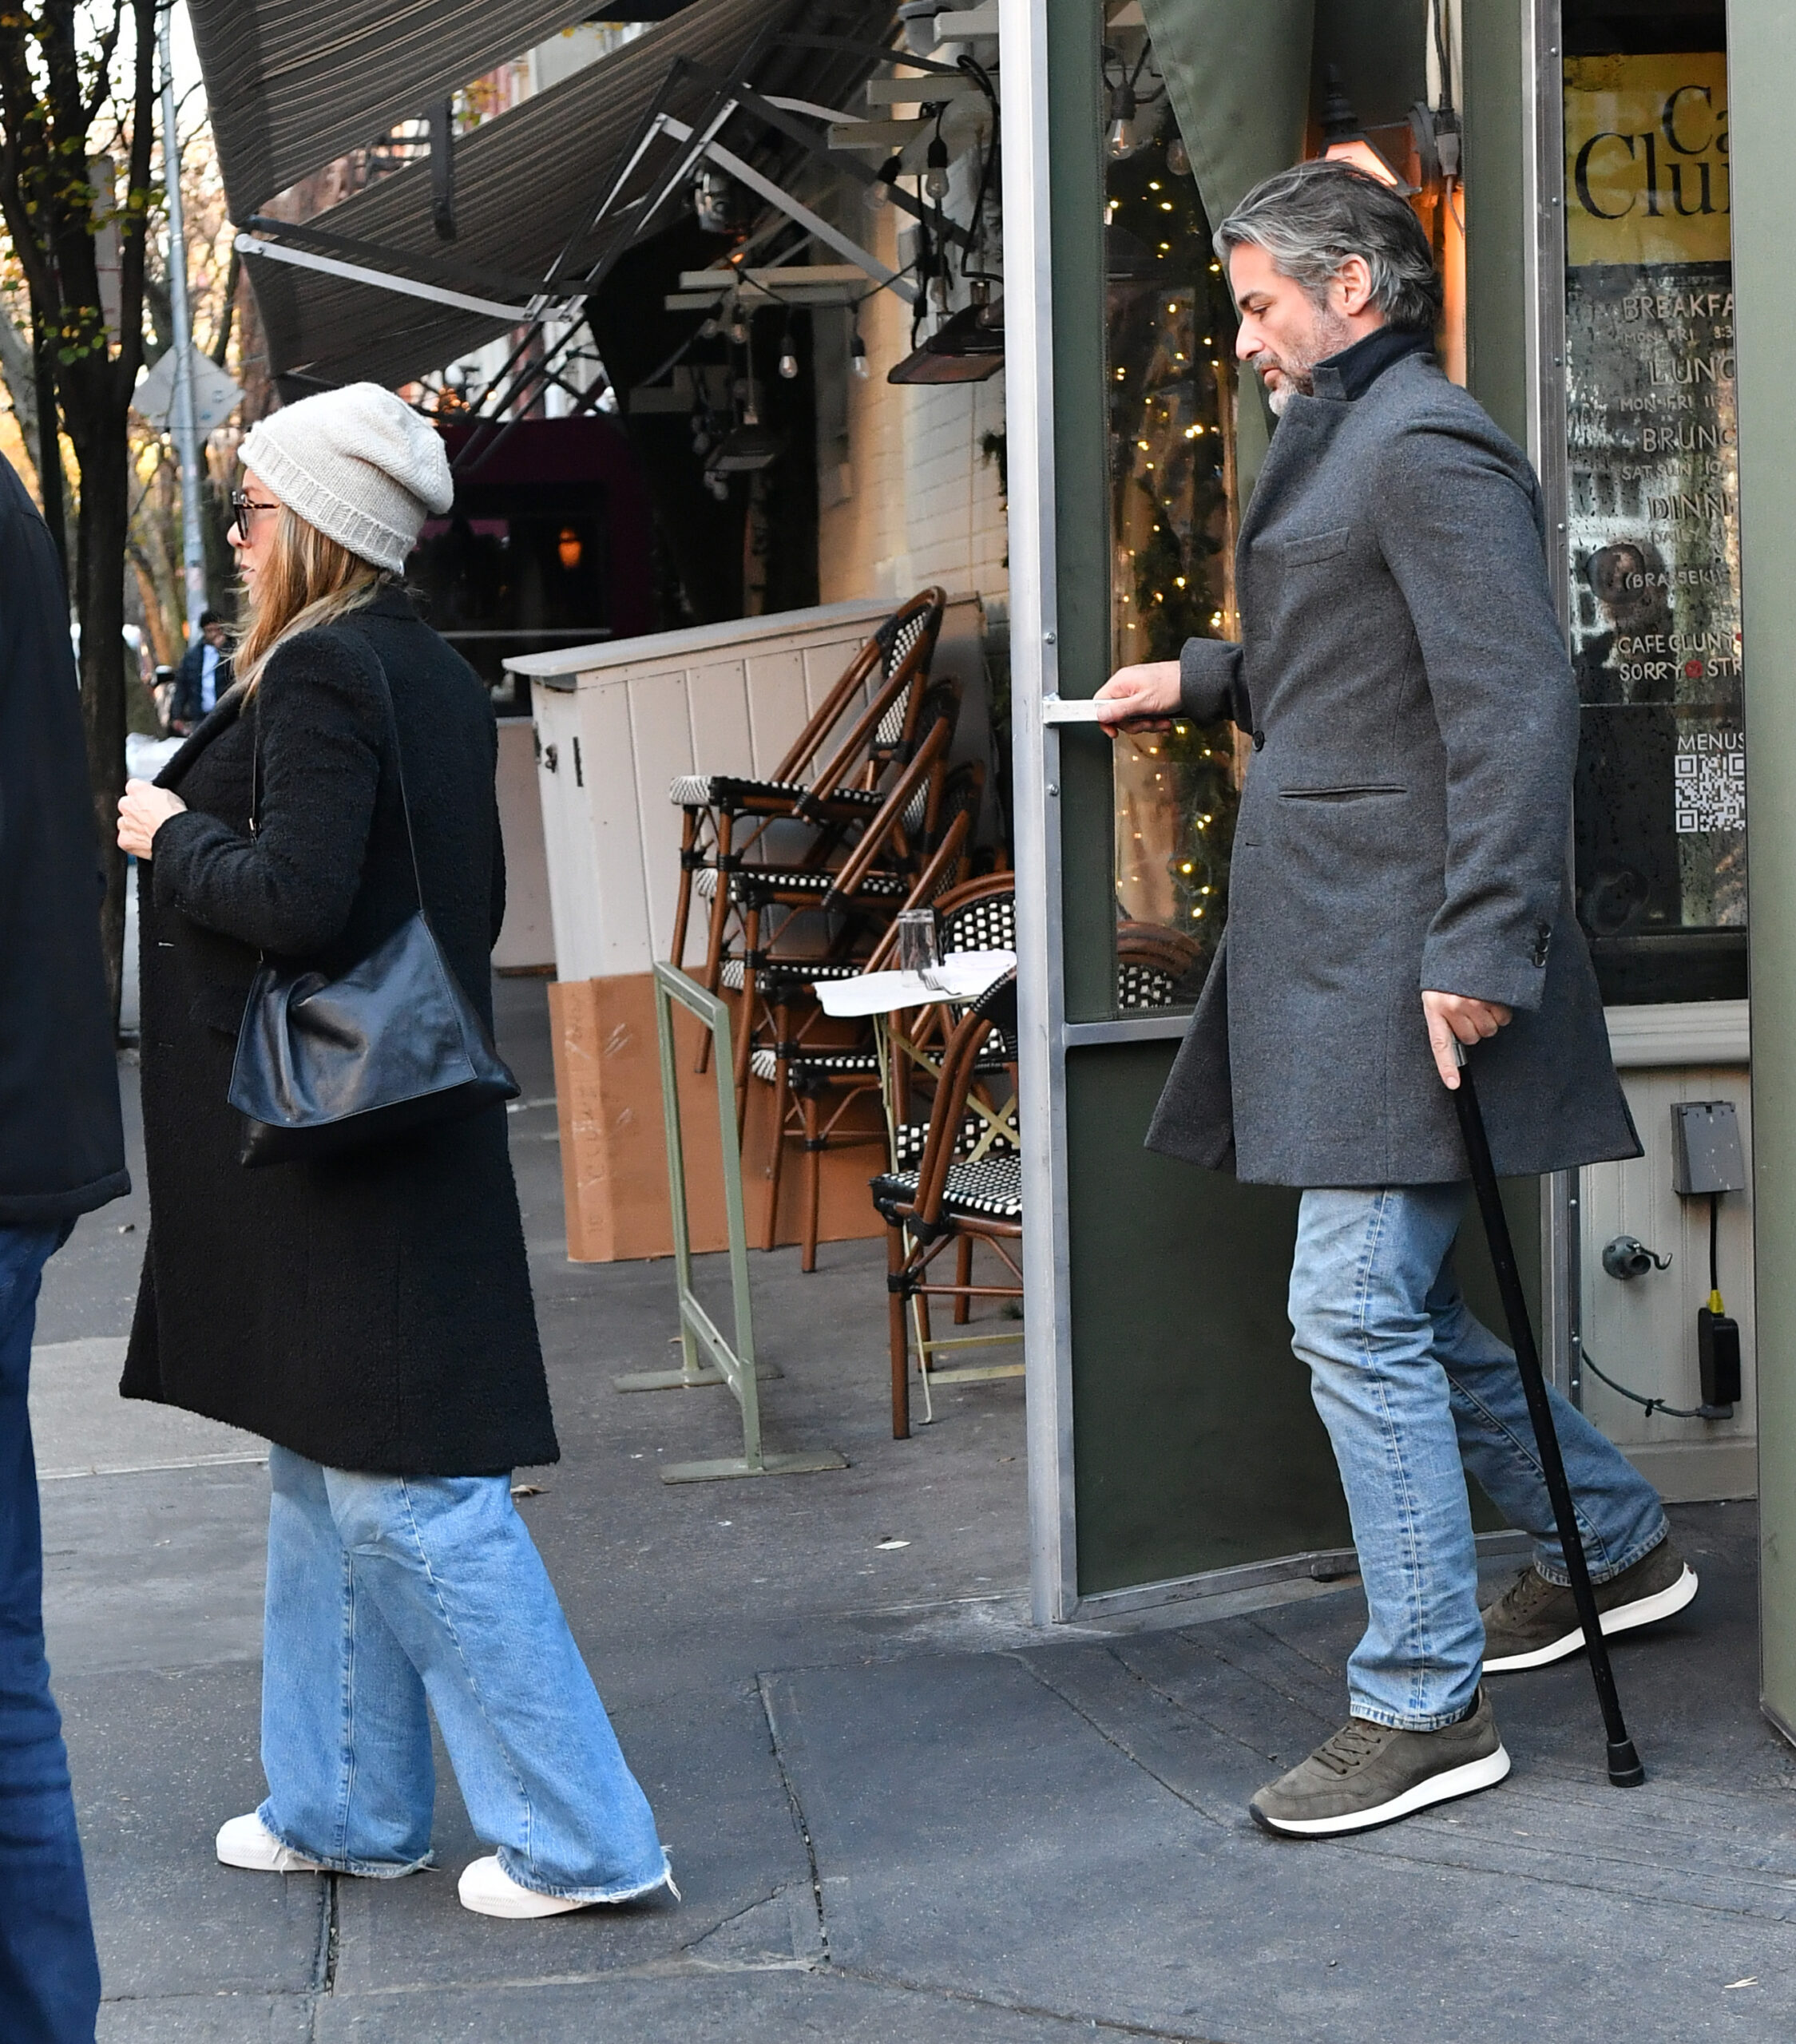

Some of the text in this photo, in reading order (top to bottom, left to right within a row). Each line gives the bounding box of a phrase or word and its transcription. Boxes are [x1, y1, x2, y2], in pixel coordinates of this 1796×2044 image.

[1575, 132, 1731, 220] Clu
[1618, 632, 1735, 654] CAFE CLUNY
[1620, 661, 1683, 681] SORRY
